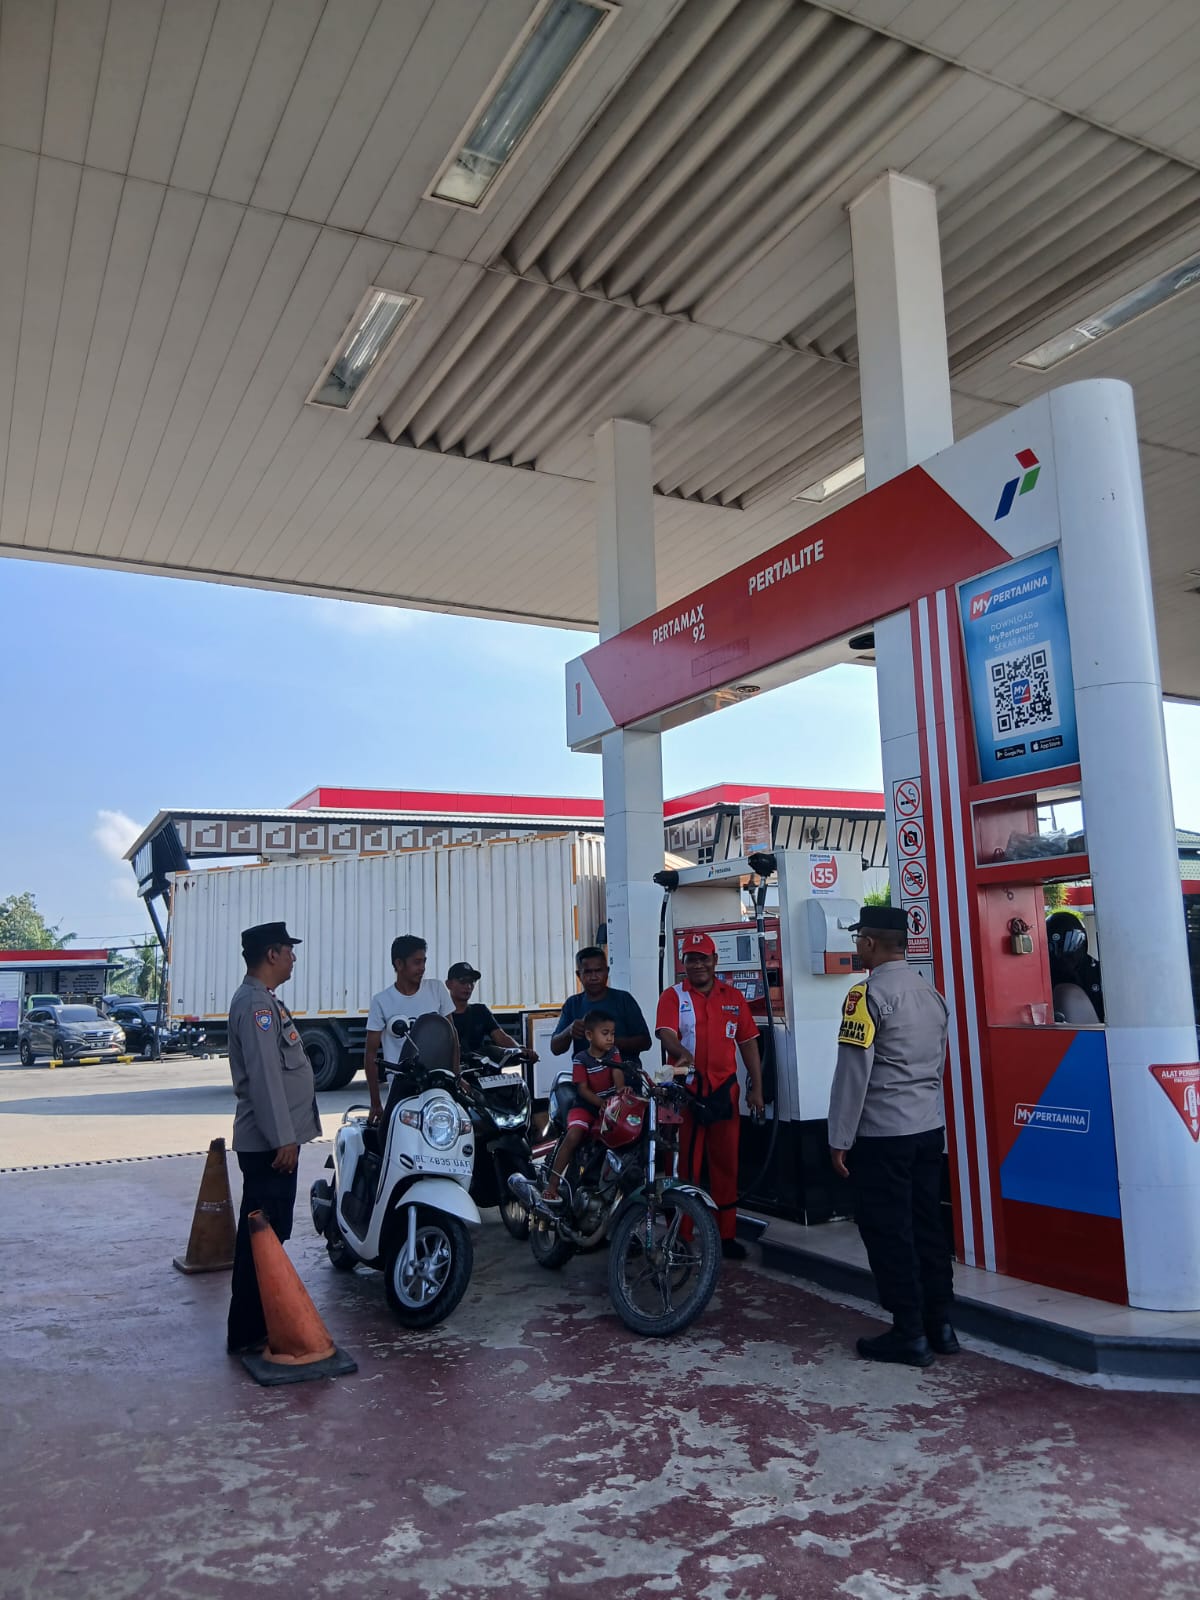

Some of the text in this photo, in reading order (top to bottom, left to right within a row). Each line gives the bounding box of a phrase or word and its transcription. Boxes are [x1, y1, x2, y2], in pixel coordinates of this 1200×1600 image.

[748, 539, 824, 595] PERTALITE
[652, 604, 704, 645] PERTAMAX
[991, 612, 1034, 631] DOWNLOAD
[692, 624, 706, 643] 92
[989, 622, 1039, 644] MyPertamina
[995, 633, 1036, 651] SEKARANG
[575, 682, 582, 716] 1
[812, 867, 835, 883] 135
[1161, 1070, 1177, 1078] ALAT
